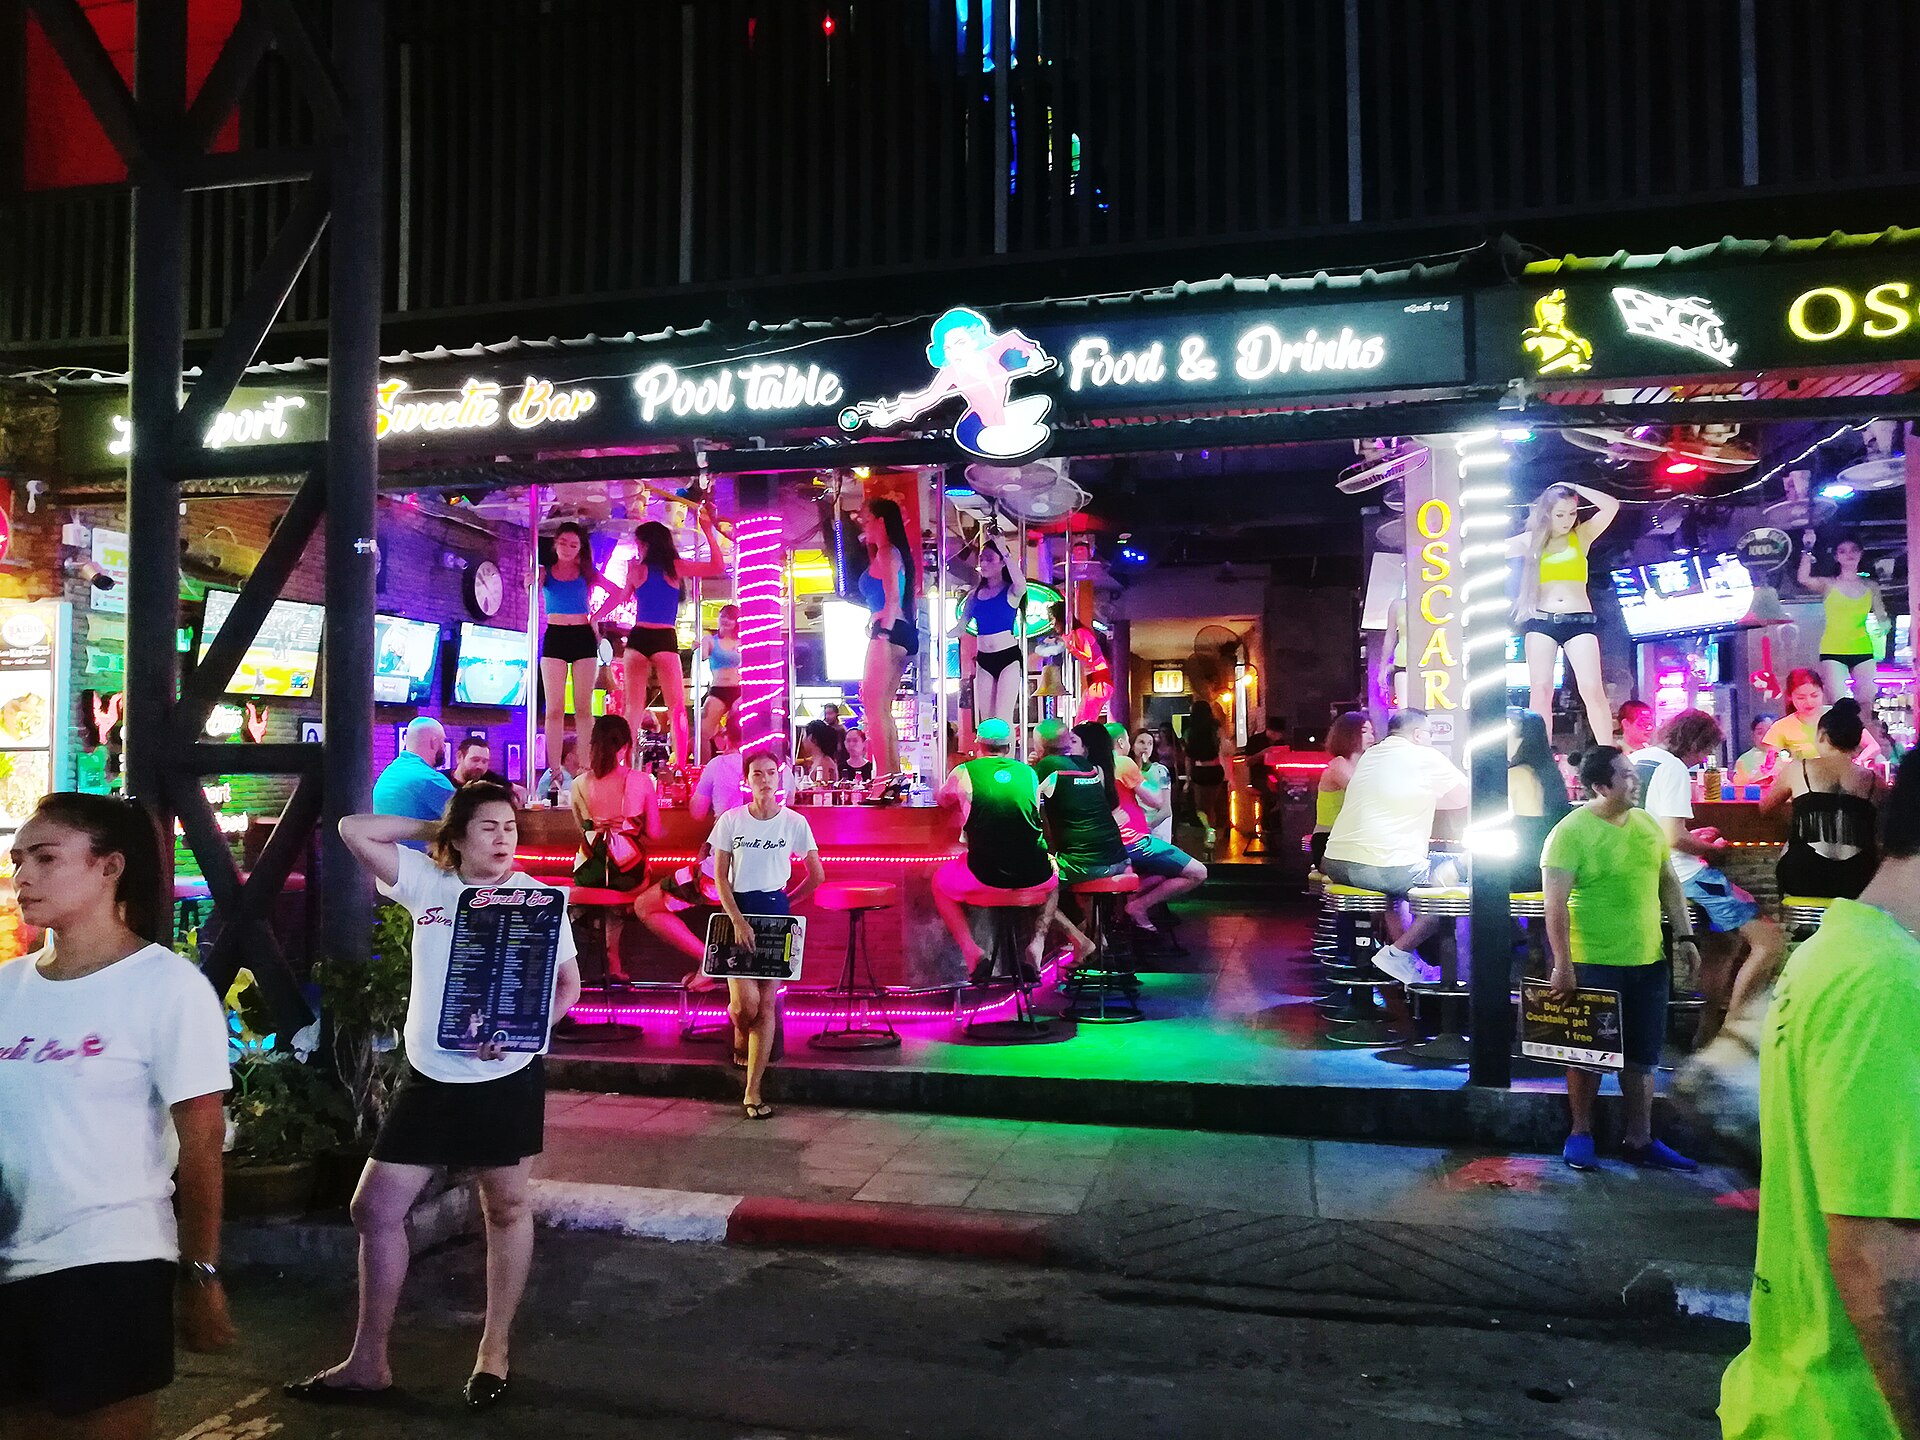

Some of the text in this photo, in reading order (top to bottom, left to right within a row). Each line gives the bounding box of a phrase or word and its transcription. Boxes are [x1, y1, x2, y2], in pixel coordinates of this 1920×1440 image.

[1787, 281, 1920, 343] OS
[1068, 323, 1386, 392] Food & Drinks
[507, 375, 597, 430] Bar
[635, 364, 736, 422] Pool
[1415, 498, 1459, 711] OSCAR
[469, 886, 555, 909] Sweetie Bar
[1526, 1011, 1588, 1028] Cocktails get
[1544, 1002, 1560, 1013] Buy
[1584, 1005, 1591, 1015] 2
[1565, 1031, 1593, 1042] 1 free
